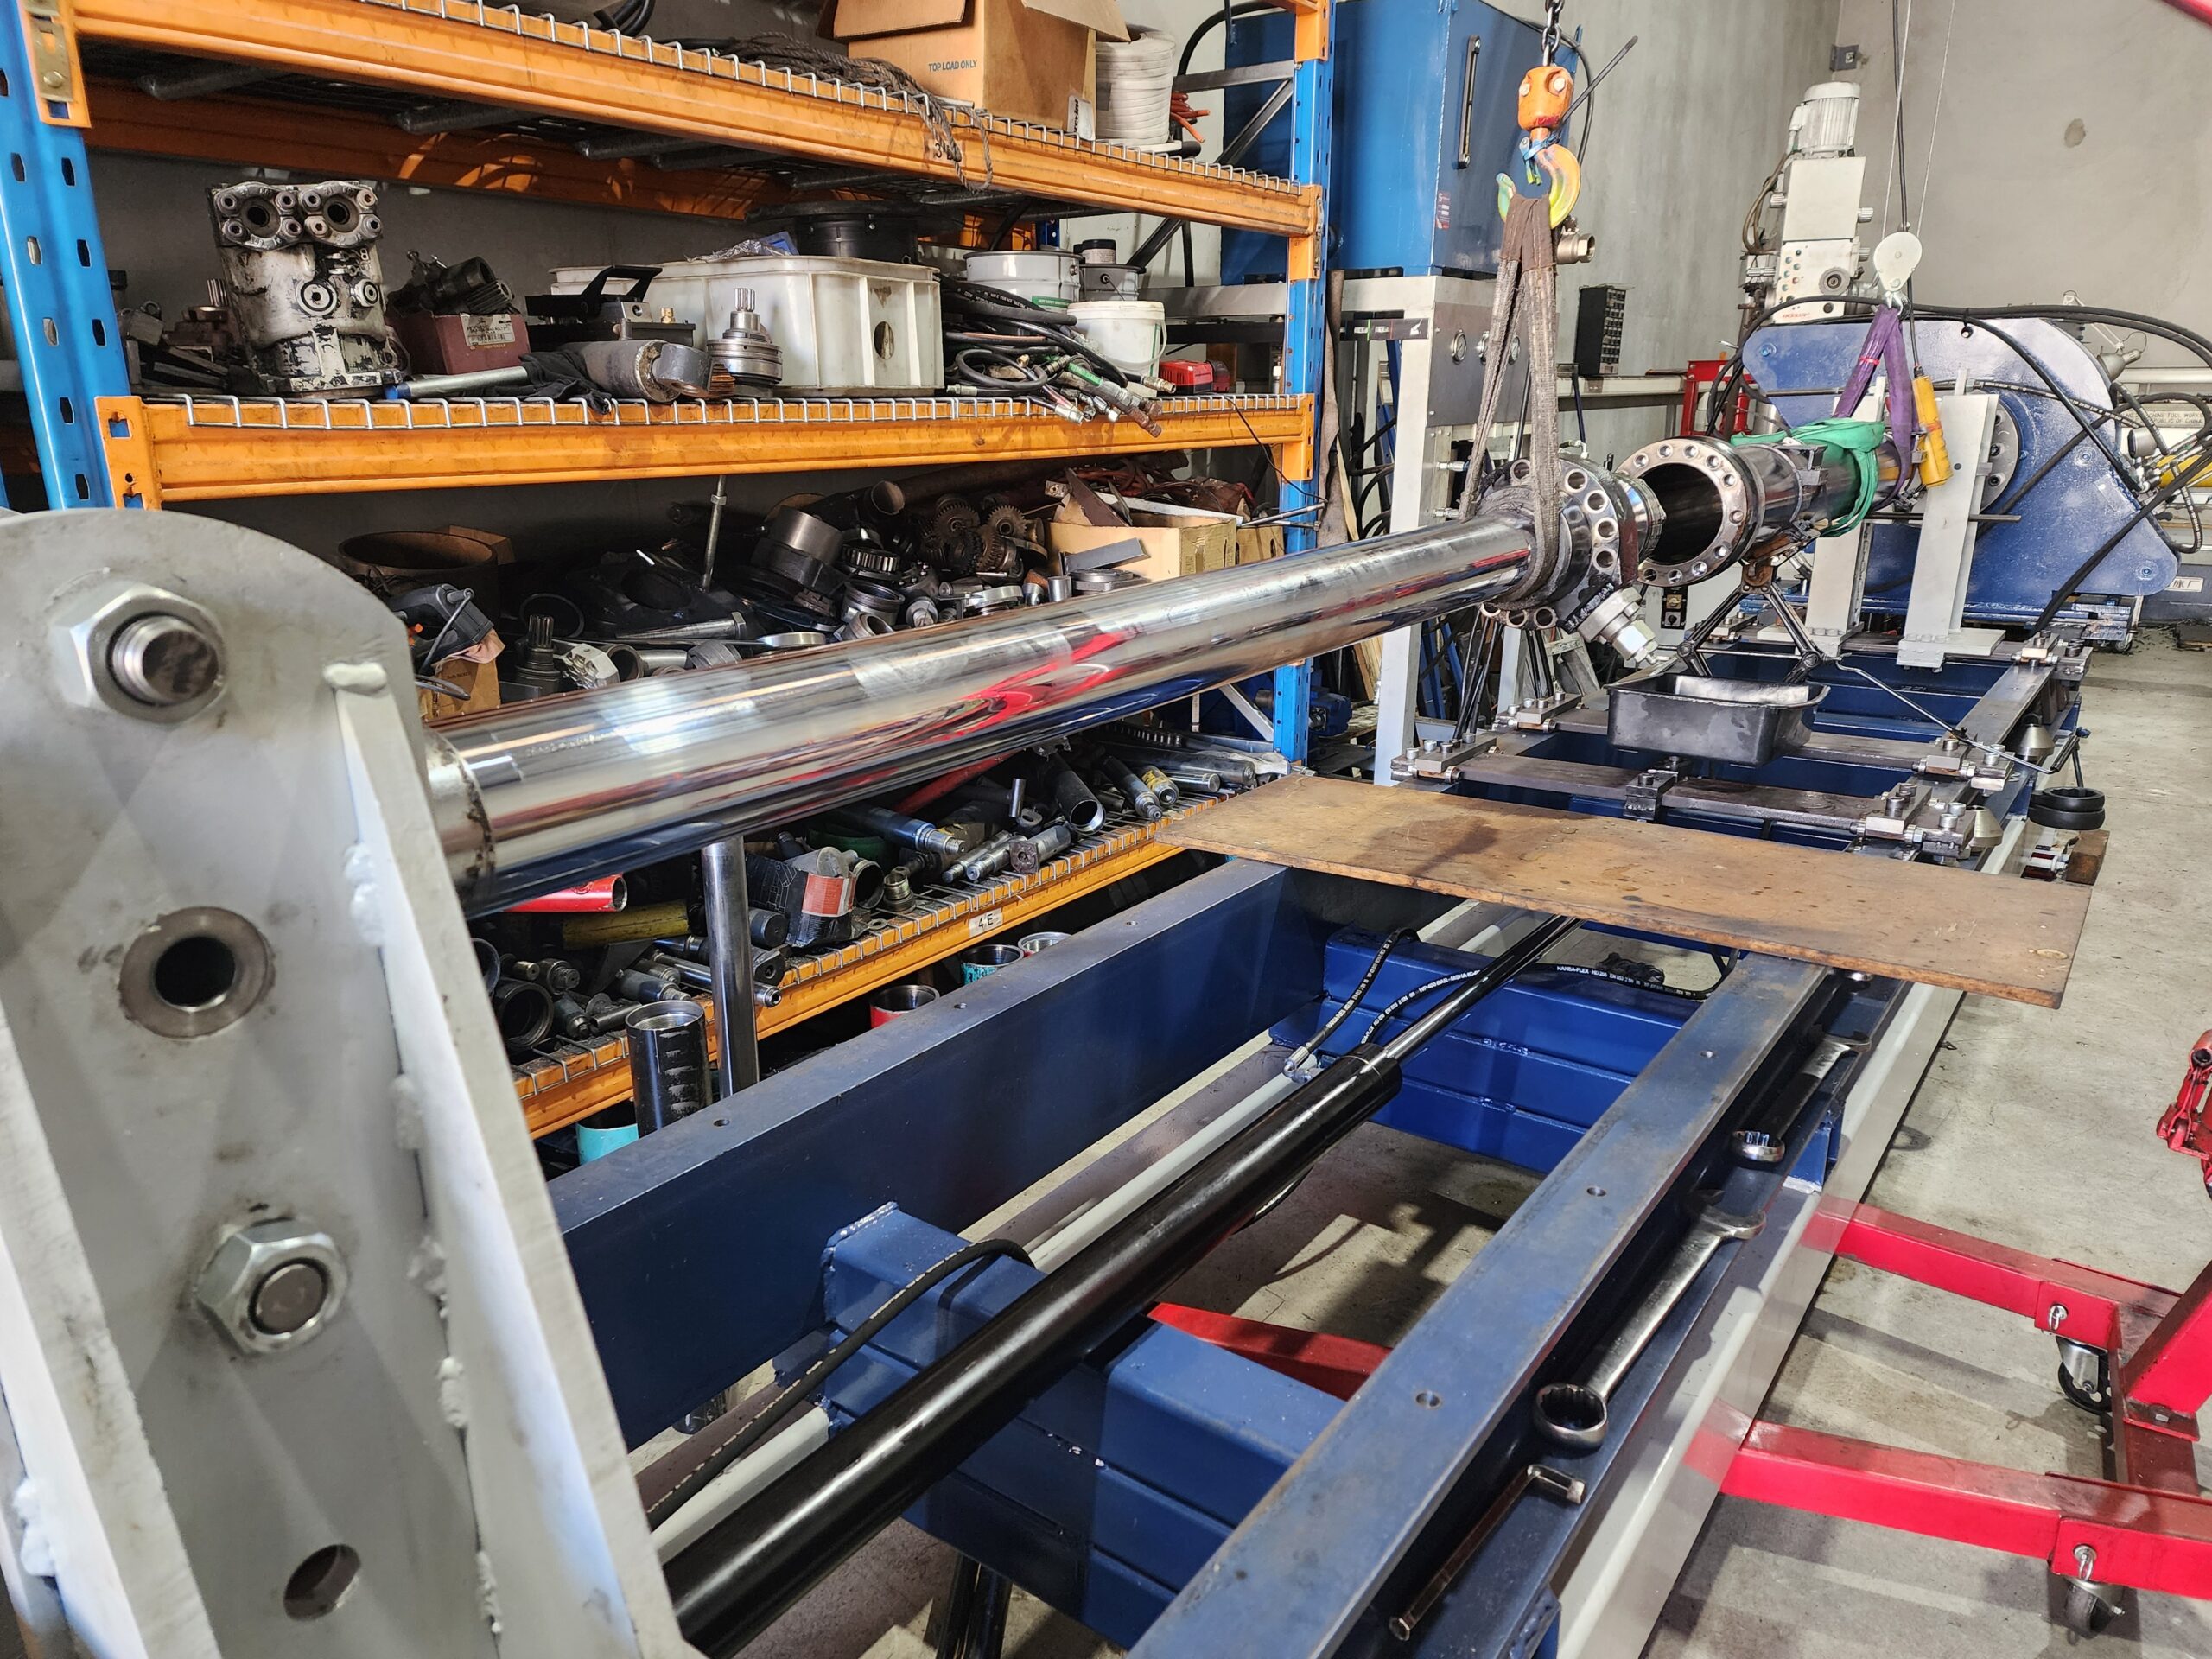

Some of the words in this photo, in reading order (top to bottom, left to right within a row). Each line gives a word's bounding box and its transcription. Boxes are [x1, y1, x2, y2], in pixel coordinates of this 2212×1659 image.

[928, 62, 942, 73] TOP
[942, 60, 959, 71] LOAD
[961, 59, 978, 69] ONLY
[1556, 965, 1590, 976] HANSA-FLEX
